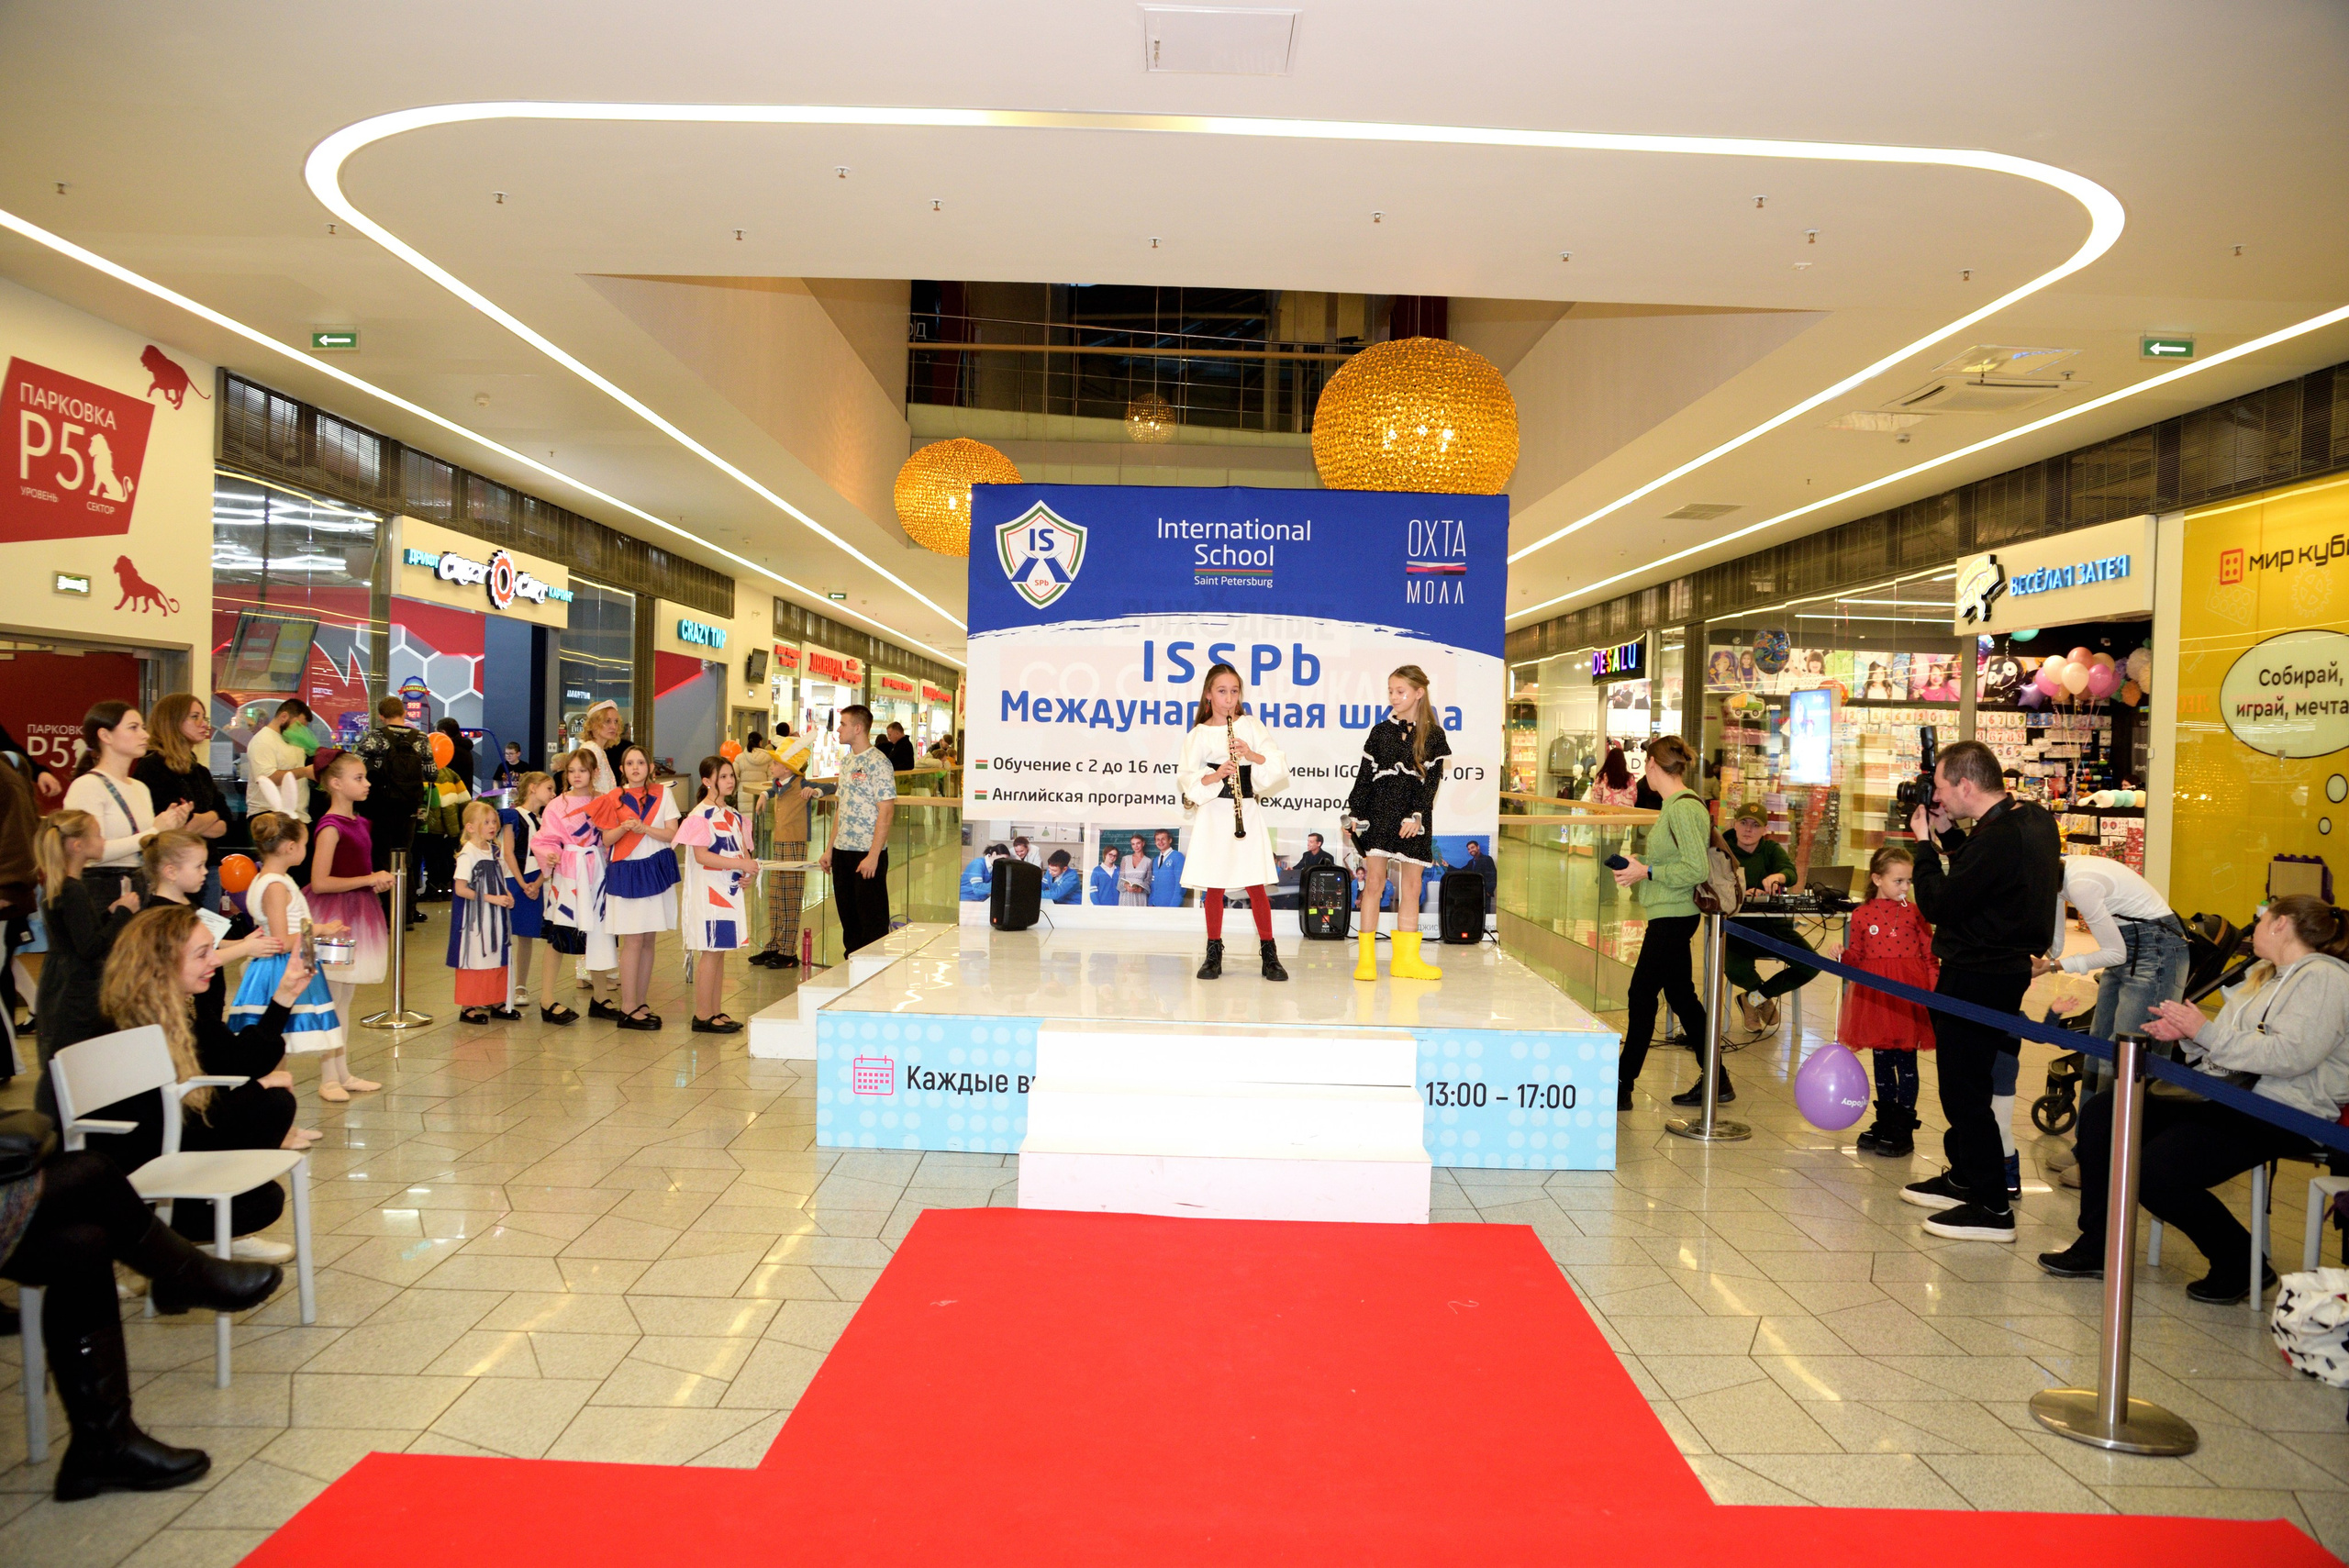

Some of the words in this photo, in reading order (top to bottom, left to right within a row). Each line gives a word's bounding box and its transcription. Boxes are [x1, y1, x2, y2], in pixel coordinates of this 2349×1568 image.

[20, 382, 117, 430] ПАРКОВКА
[20, 409, 84, 490] P5
[20, 486, 59, 503] УРОВЕНЬ
[86, 501, 116, 515] СЕКТОР
[1030, 528, 1054, 551] IS
[1158, 517, 1311, 541] International
[1408, 519, 1466, 557] ОХТА
[1195, 544, 1274, 566] School
[2299, 534, 2349, 567] куб
[1194, 576, 1219, 586] Saint
[1221, 577, 1274, 588] Petersburg
[2009, 565, 2075, 596] ВЕСЁЛАЯ
[2076, 554, 2130, 585] ЗАТЕЯ
[680, 618, 710, 645] CRAZY
[1592, 643, 1637, 675] DESALU
[2259, 661, 2343, 688] Собирай,
[406, 701, 422, 709] 999
[406, 710, 422, 718] 427
[2236, 695, 2288, 721] играй,
[994, 757, 1071, 773] Обучение
[1076, 761, 1084, 772] с
[1088, 759, 1097, 772] 2
[1103, 761, 1122, 774] до
[1129, 760, 1148, 773] 16
[1153, 762, 1179, 773] лет
[1453, 767, 1485, 780] ОГЭ
[993, 788, 1083, 803] Английская
[1088, 793, 1176, 806] программа
[907, 1065, 1008, 1095] Каждые
[1426, 1082, 1486, 1107] 13:00
[1518, 1084, 1576, 1109] 17:00
